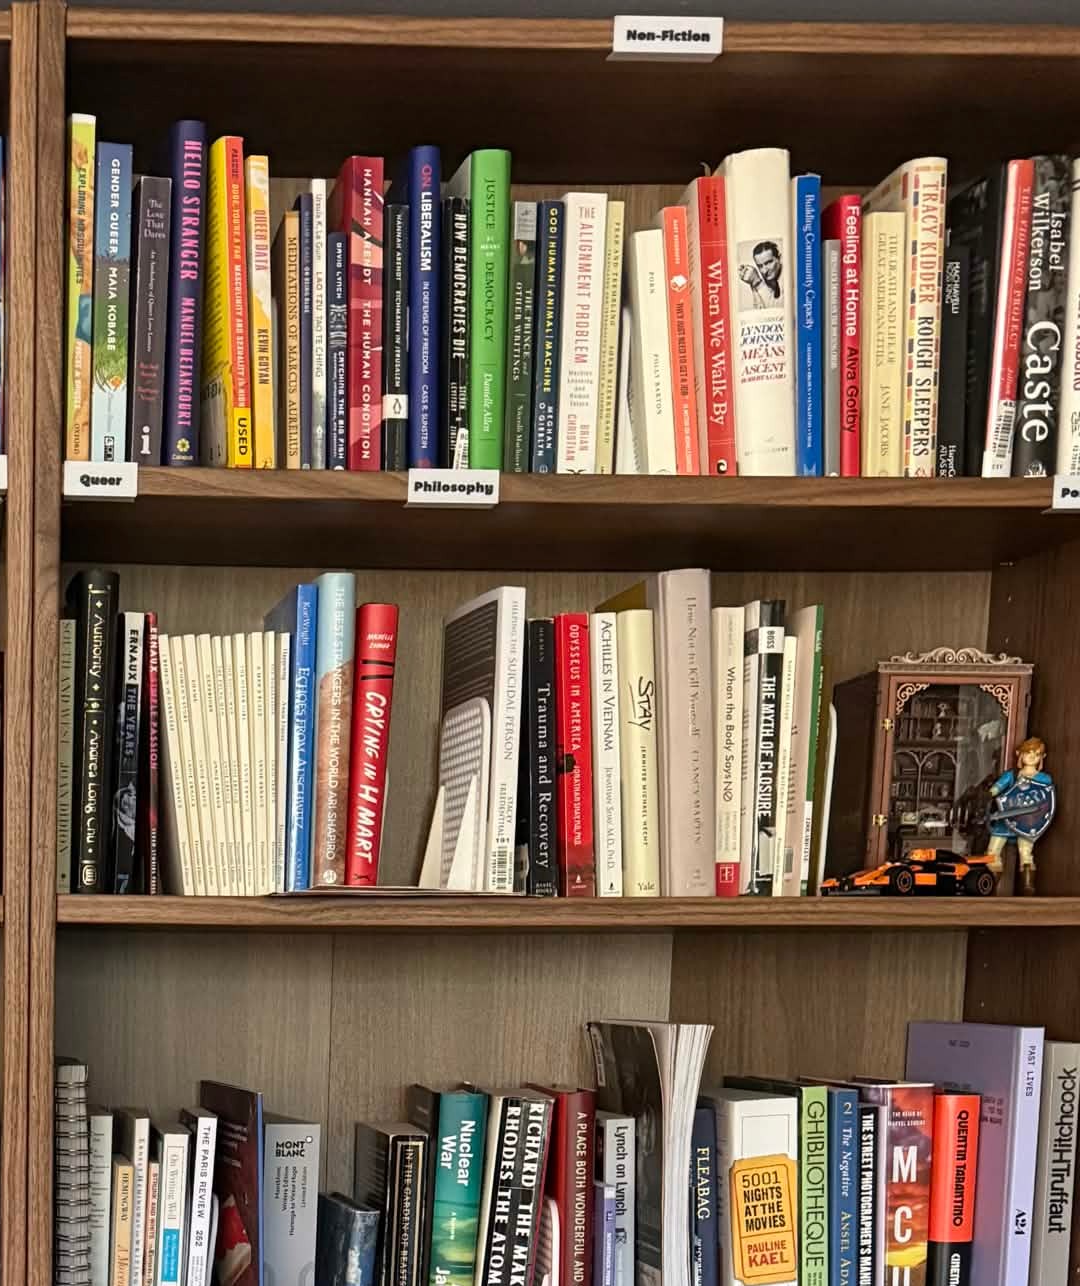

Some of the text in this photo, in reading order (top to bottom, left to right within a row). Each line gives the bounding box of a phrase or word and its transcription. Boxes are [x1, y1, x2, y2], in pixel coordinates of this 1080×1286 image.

[626, 29, 710, 43] Non-Fiction
[180, 140, 202, 280] HELLO STRANGER
[420, 192, 432, 271] LIBERALISM
[485, 178, 496, 230] JUSTICE
[106, 159, 119, 350] GENDER QUEER MAIA KOBABE
[1029, 193, 1050, 291] Wilkerson
[1049, 211, 1065, 272] Isabel
[360, 169, 373, 460] HANNAH ARENDT THE HUMAN CONDITION
[453, 214, 465, 359] HOW DEMOCRACIES DIE
[483, 262, 495, 343] DEMOCRACY
[843, 205, 860, 433] Feeling at Home Alva Gotby
[707, 261, 728, 425] When We Walk By
[913, 316, 934, 456] ROUGH SLEEPERS
[1023, 320, 1061, 443] Caste
[238, 417, 248, 455] USED
[79, 473, 122, 488] Queer
[414, 480, 494, 495] Philosophy
[600, 620, 615, 751] ACHILLES IN VIETNAM
[628, 676, 654, 730] STAY
[355, 691, 386, 863] CRYING IN H MART
[536, 683, 552, 868] Trauma and Recovery
[637, 882, 655, 892] Yale
[1025, 1046, 1036, 1096] PAST LIVES
[276, 1141, 305, 1149] MONT
[500, 1106, 520, 1180] RHODES
[521, 1103, 544, 1188] RICHARD
[1053, 1067, 1077, 1163] Hitchcock
[276, 1149, 305, 1157] BLANC
[441, 1136, 457, 1169] War
[457, 1120, 476, 1187] Nuclear
[697, 1148, 710, 1220] FLEABAG
[742, 1171, 780, 1187] 5001
[806, 1101, 825, 1266] GHIBLIOTHEQUE
[744, 1186, 782, 1204] NIGHTS
[745, 1203, 783, 1217] AT THE
[745, 1215, 786, 1232] MOVIES
[1048, 1161, 1070, 1233] Truffaut
[748, 1240, 787, 1255] PAULINE
[748, 1252, 789, 1268] KAEL
